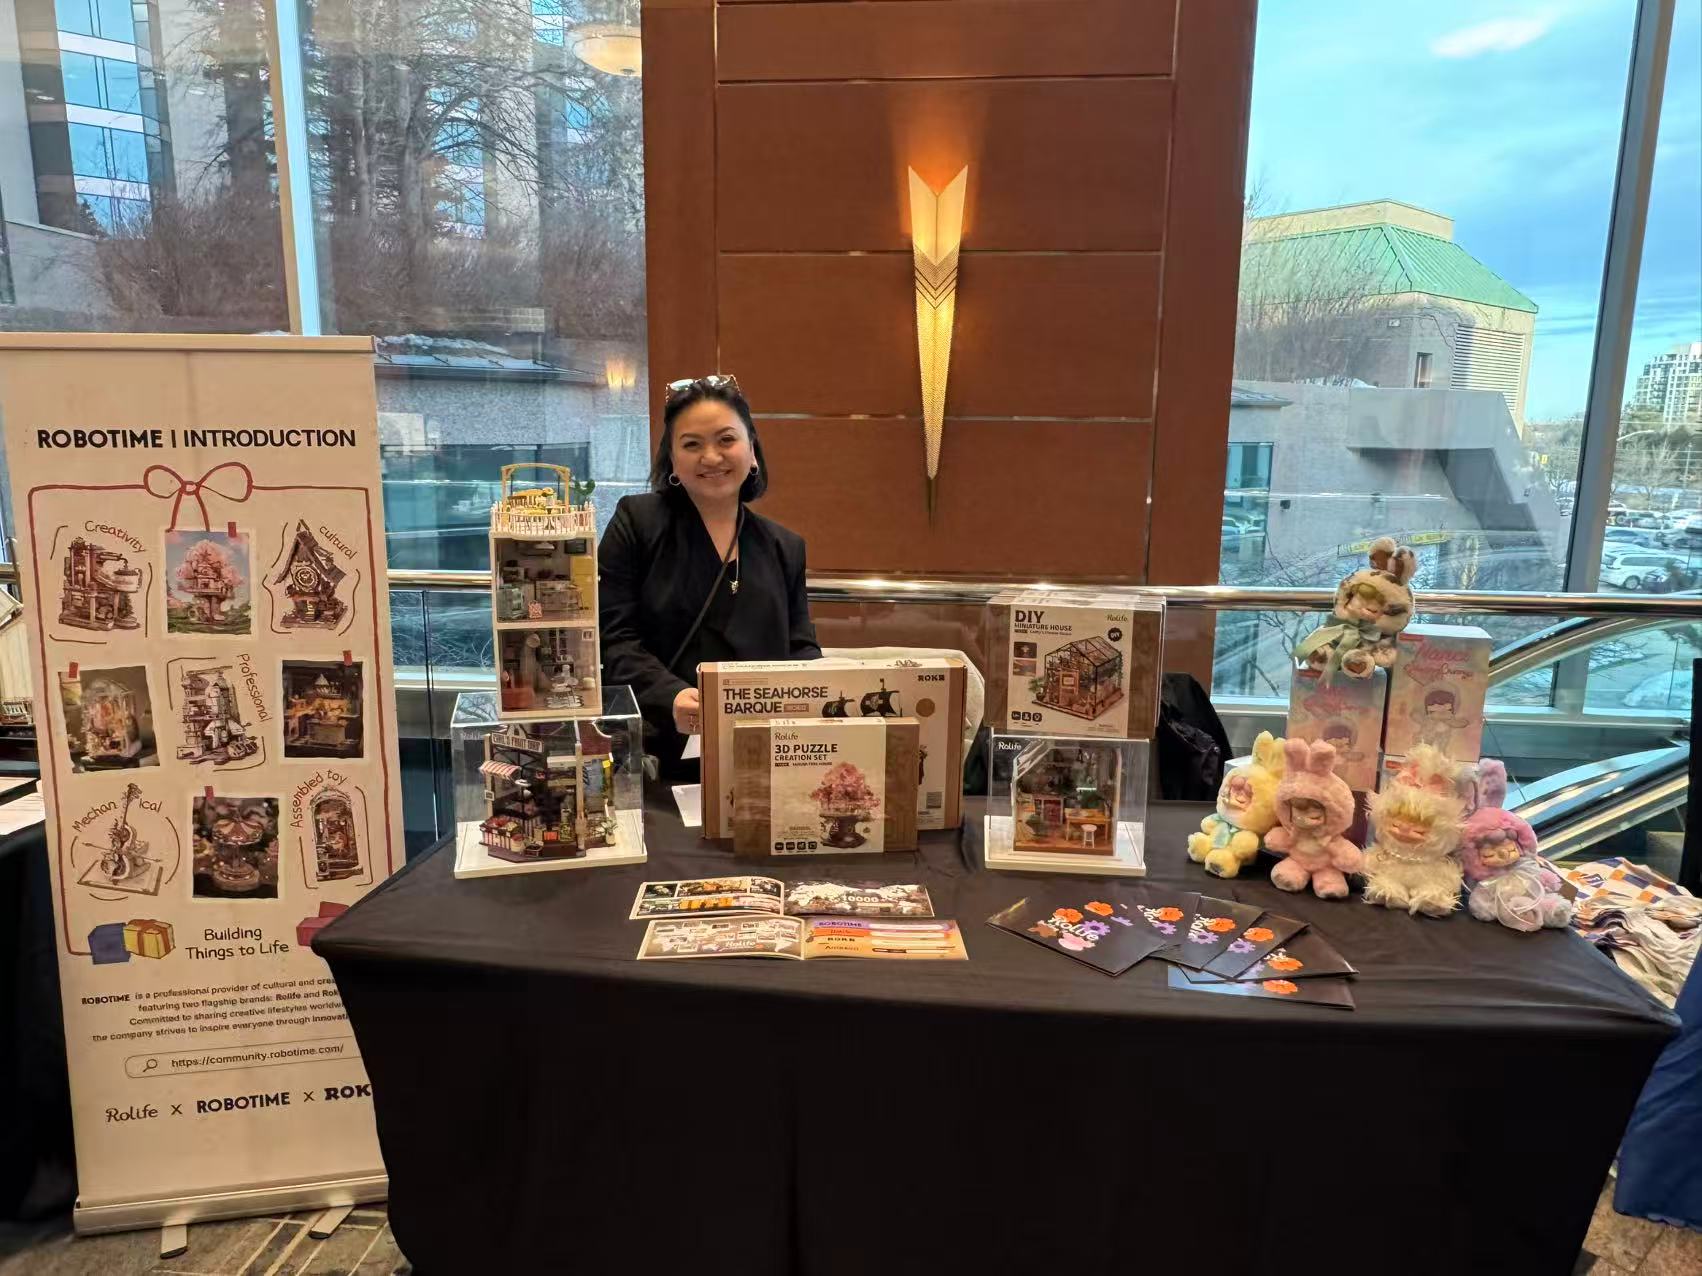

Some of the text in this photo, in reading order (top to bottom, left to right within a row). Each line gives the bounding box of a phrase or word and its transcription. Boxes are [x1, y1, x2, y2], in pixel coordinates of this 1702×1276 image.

[37, 428, 163, 448] ROBOTIME
[183, 428, 357, 448] INTRODUCTION
[84, 519, 146, 553] Creativity
[1014, 622, 1049, 630] MINIATURE
[1015, 609, 1045, 623] DIY
[236, 653, 273, 722] Professional
[918, 674, 945, 682] ROKR
[723, 686, 828, 700] THE SEAHORSE
[724, 702, 782, 714] BARQUE
[774, 732, 798, 740] Rolife
[998, 741, 1022, 751] Rolife
[775, 744, 838, 754] 3D PUZZLE
[290, 769, 347, 829] Assembled toy
[71, 799, 118, 832] Mechan
[204, 927, 262, 943] Building
[1048, 917, 1099, 941] Rolife
[185, 940, 289, 961] Things to Life
[81, 994, 130, 1005] ROBOTIME
[135, 992, 143, 1000] is
[153, 986, 209, 999] professional
[211, 983, 249, 995] provider
[251, 982, 261, 990] of
[263, 980, 296, 990] cultural
[298, 979, 315, 987] and
[138, 1000, 180, 1012] featuring
[182, 1001, 199, 1009] two
[201, 998, 238, 1009] flagship
[276, 992, 301, 1001] Rolife
[303, 990, 320, 999] and
[129, 1014, 180, 1026] Committed
[182, 1013, 192, 1021] to
[193, 1010, 228, 1022] sharing
[229, 1008, 265, 1018] creative
[267, 1004, 307, 1015] lifestyles
[92, 1034, 108, 1042] the
[110, 1030, 153, 1042] company
[155, 1026, 186, 1036] strives
[199, 1022, 230, 1034] inspire
[232, 1019, 274, 1030] everyone
[276, 1016, 311, 1028] through
[171, 1044, 345, 1069] https://community.robotime.com/
[105, 1102, 159, 1123] Rolife
[196, 1091, 291, 1115] ROBOTIME
